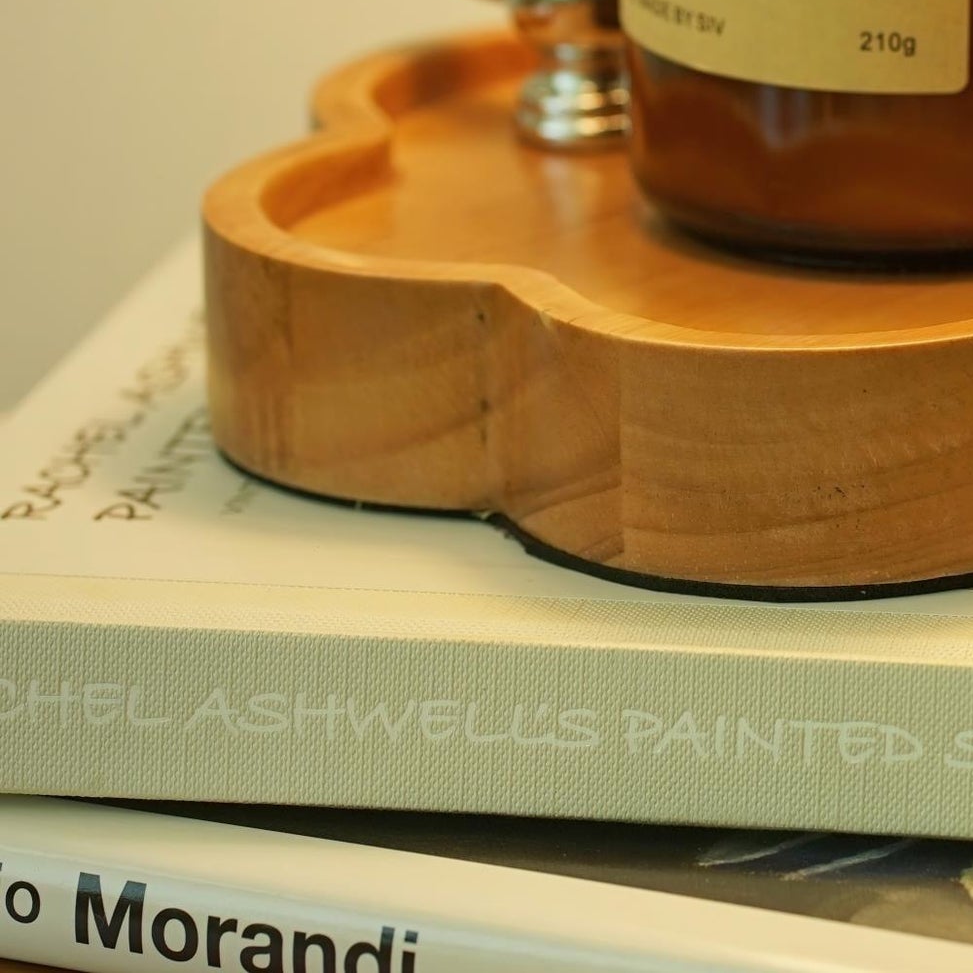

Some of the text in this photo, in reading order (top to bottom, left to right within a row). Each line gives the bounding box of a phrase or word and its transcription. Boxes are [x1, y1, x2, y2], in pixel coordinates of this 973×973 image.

[859, 30, 917, 57] 210g
[183, 688, 600, 748] ASHWELL'S
[622, 709, 923, 764] PAINTED
[75, 872, 420, 973] Morandi
